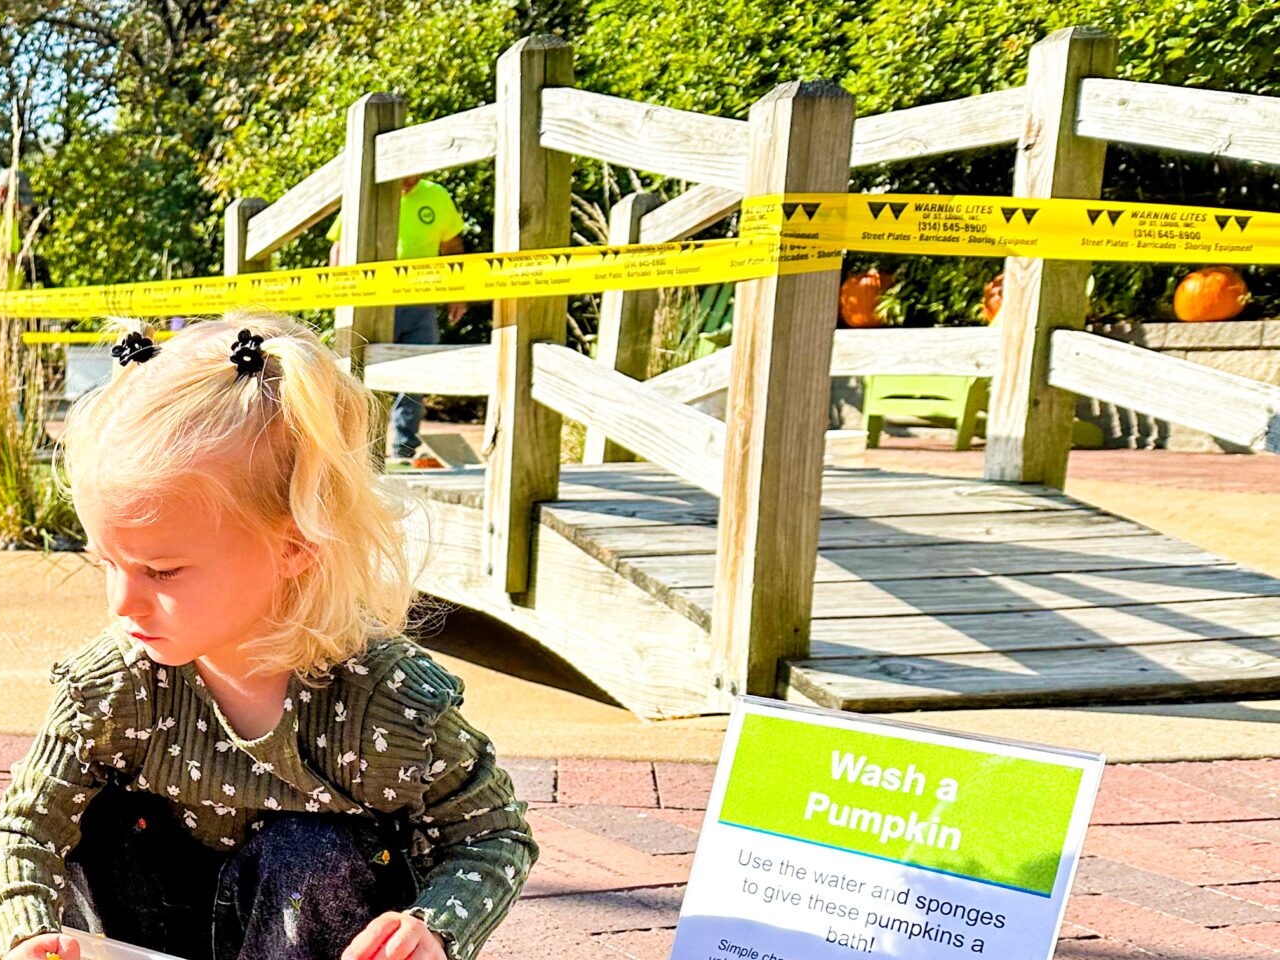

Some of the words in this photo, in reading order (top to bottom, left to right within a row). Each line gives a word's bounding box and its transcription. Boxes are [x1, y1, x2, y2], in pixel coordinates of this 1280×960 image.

[914, 202, 962, 213] WARNING
[965, 204, 994, 215] LITES
[1130, 209, 1177, 221] WARNING
[1180, 212, 1208, 222] LITES
[918, 221, 940, 232] (314)
[942, 222, 987, 233] 645-8900
[1134, 228, 1155, 239] (314)
[1157, 230, 1201, 240] 645-8900
[862, 231, 886, 240] Street
[887, 232, 911, 241] Plates
[919, 233, 961, 242] Barricades
[967, 235, 996, 245] Shoring
[1081, 238, 1103, 246] Street
[1105, 239, 1129, 247] Plates
[1136, 240, 1176, 249] Barricades
[1184, 242, 1212, 251] Shoring
[1214, 243, 1253, 252] Equipment
[830, 750, 926, 796] Wash
[935, 777, 958, 802] a
[804, 791, 962, 851] Pumpkin
[738, 849, 773, 873] Use
[778, 860, 807, 881] the
[813, 870, 867, 895] water
[871, 885, 910, 906] and
[915, 894, 1006, 930] sponges
[742, 877, 758, 895] to
[763, 885, 802, 907] give
[808, 894, 859, 921] these
[864, 909, 965, 948] pumpkins
[970, 937, 985, 954] a
[825, 926, 876, 954] bath!
[718, 939, 759, 960] Simple
